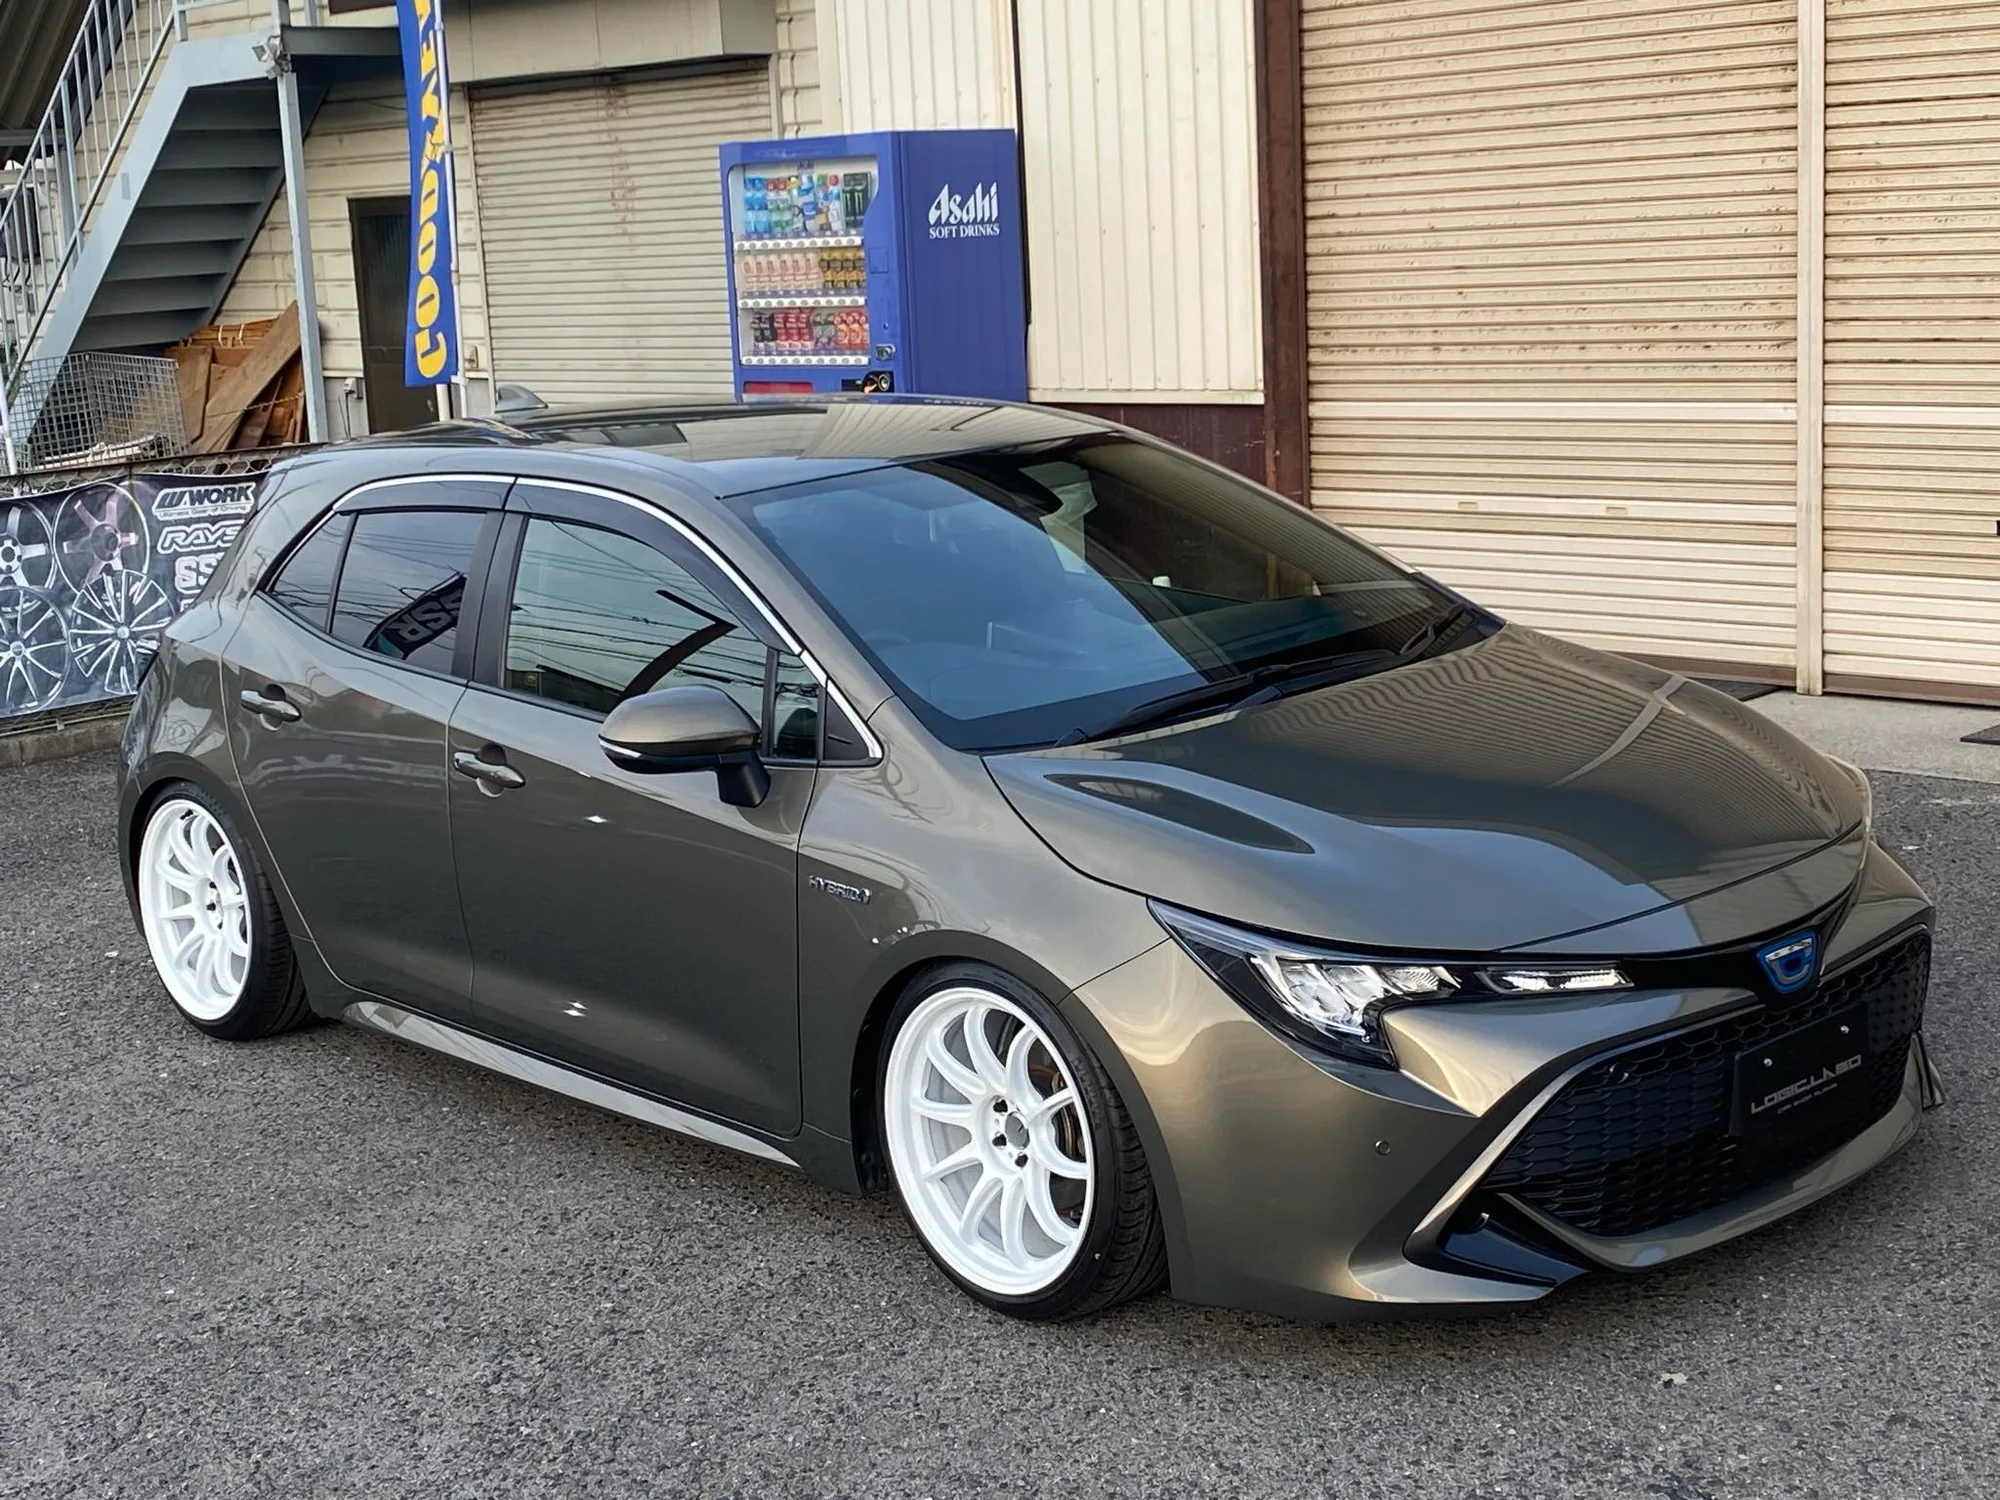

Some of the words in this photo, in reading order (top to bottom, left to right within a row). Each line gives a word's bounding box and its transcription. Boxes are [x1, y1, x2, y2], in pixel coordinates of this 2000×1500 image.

[928, 181, 999, 226] Asahi
[929, 225, 957, 239] SOFT
[960, 223, 1000, 238] DRINKS
[188, 485, 253, 507] WORK
